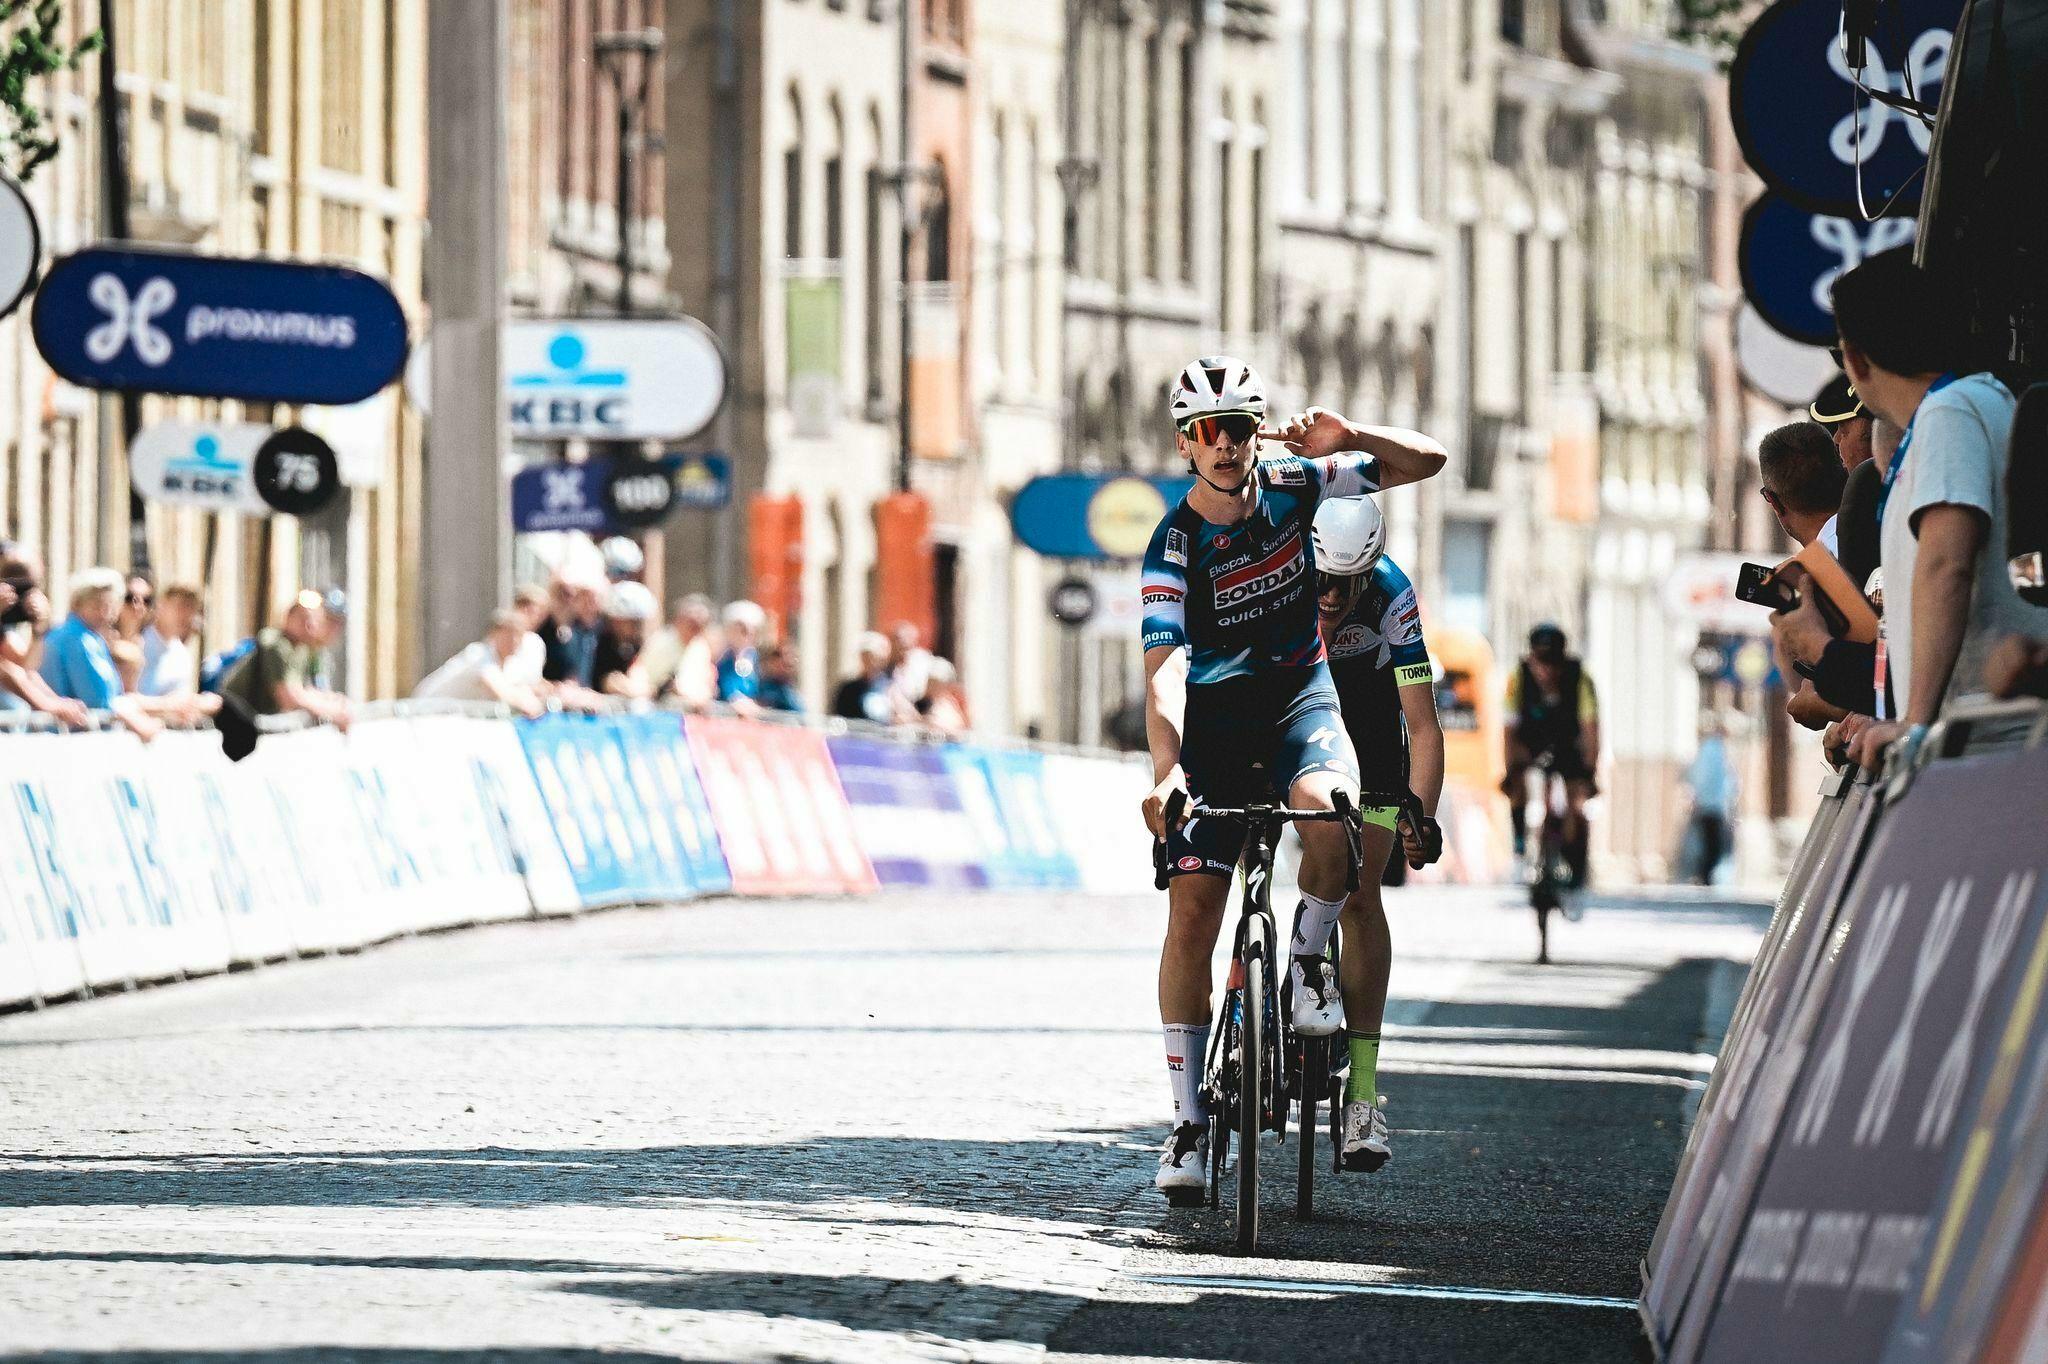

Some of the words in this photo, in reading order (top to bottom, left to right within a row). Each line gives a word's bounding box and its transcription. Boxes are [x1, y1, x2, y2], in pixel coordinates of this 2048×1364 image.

[184, 304, 357, 349] proximus
[273, 451, 321, 493] 75
[1209, 553, 1252, 578] Ekopak
[1261, 519, 1300, 554] Soenens
[1142, 594, 1181, 606] OUDAL
[1216, 556, 1304, 608] SOUDAL
